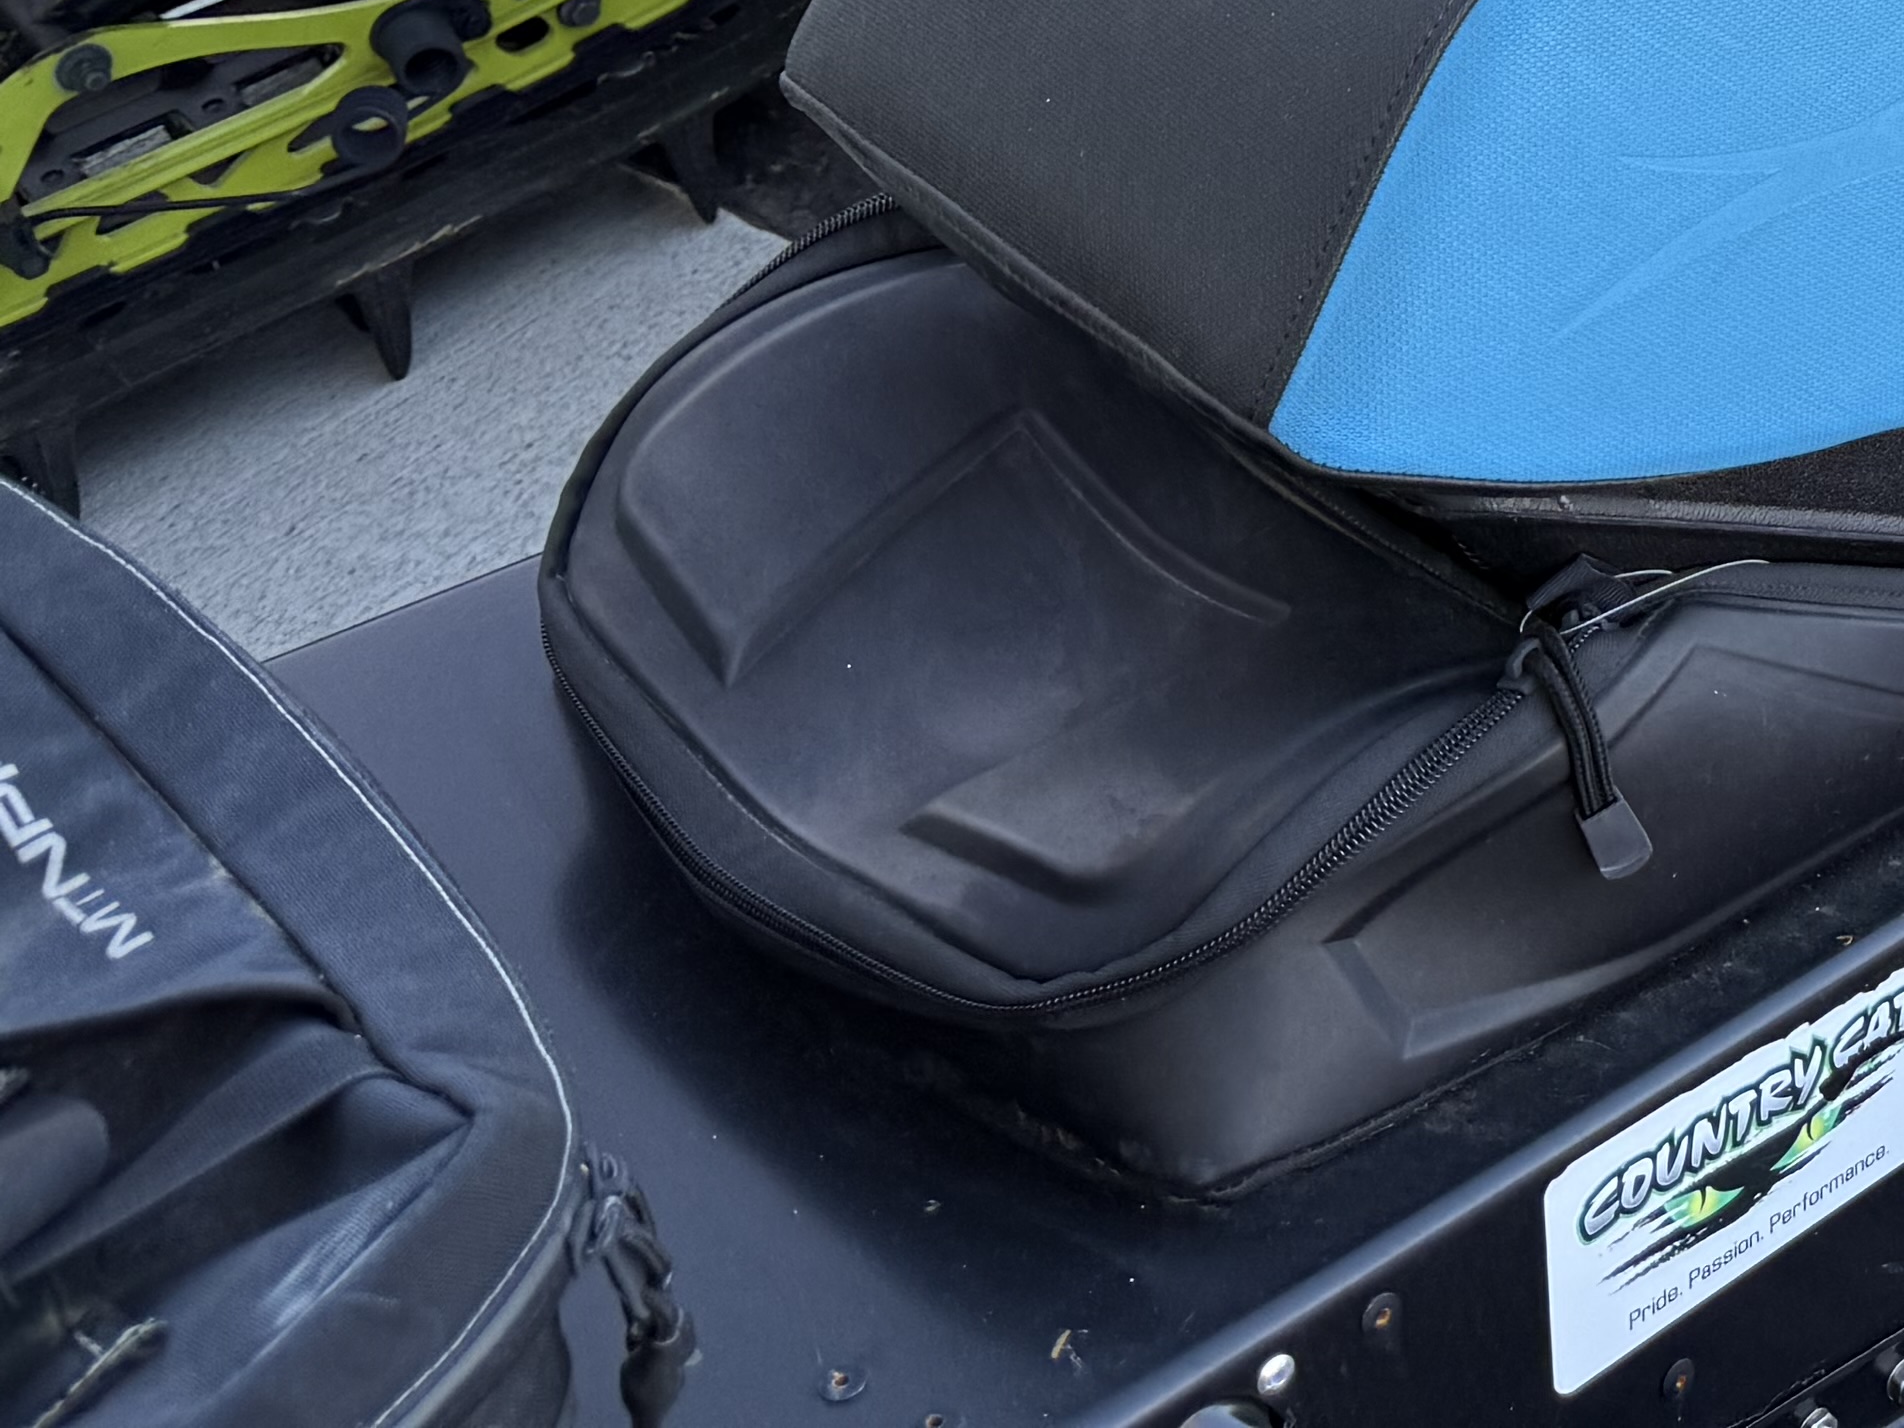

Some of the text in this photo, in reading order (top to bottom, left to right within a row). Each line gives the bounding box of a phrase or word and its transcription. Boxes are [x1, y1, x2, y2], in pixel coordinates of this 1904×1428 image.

[0, 761, 155, 959] MTNP
[1580, 1038, 1826, 1241] COUNTRY
[1629, 1144, 1891, 1330] Pride. Passion. Performance.
